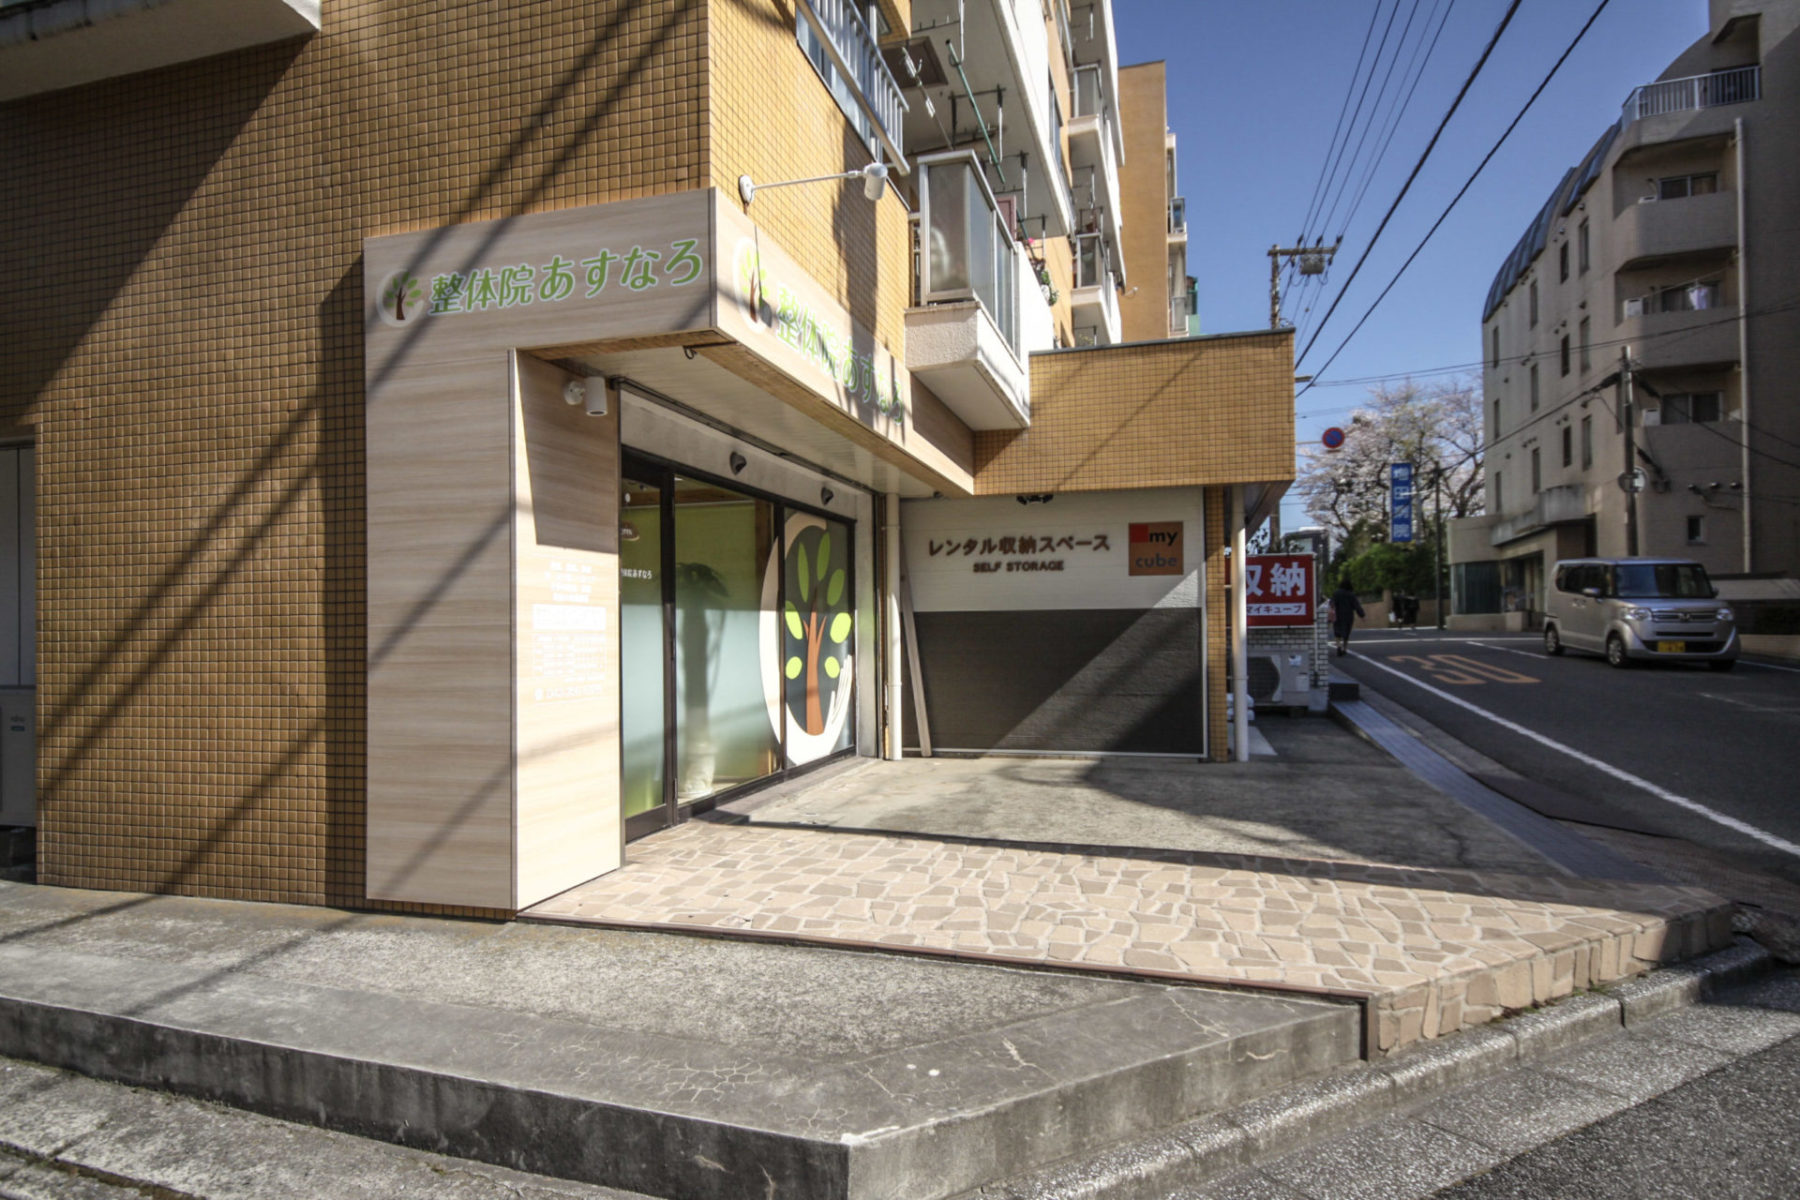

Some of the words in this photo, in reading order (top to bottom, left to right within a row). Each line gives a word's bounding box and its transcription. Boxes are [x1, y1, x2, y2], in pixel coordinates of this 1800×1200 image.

[429, 239, 702, 314] 整体院あすなろ
[776, 285, 904, 423] 整体院あすなろ
[929, 534, 1110, 556] レンタル収納スペース
[1148, 530, 1178, 545] my
[973, 561, 1001, 573] SELF
[1006, 560, 1064, 572] STORAGE
[1135, 552, 1178, 568] cube
[1386, 654, 1543, 685] 30
